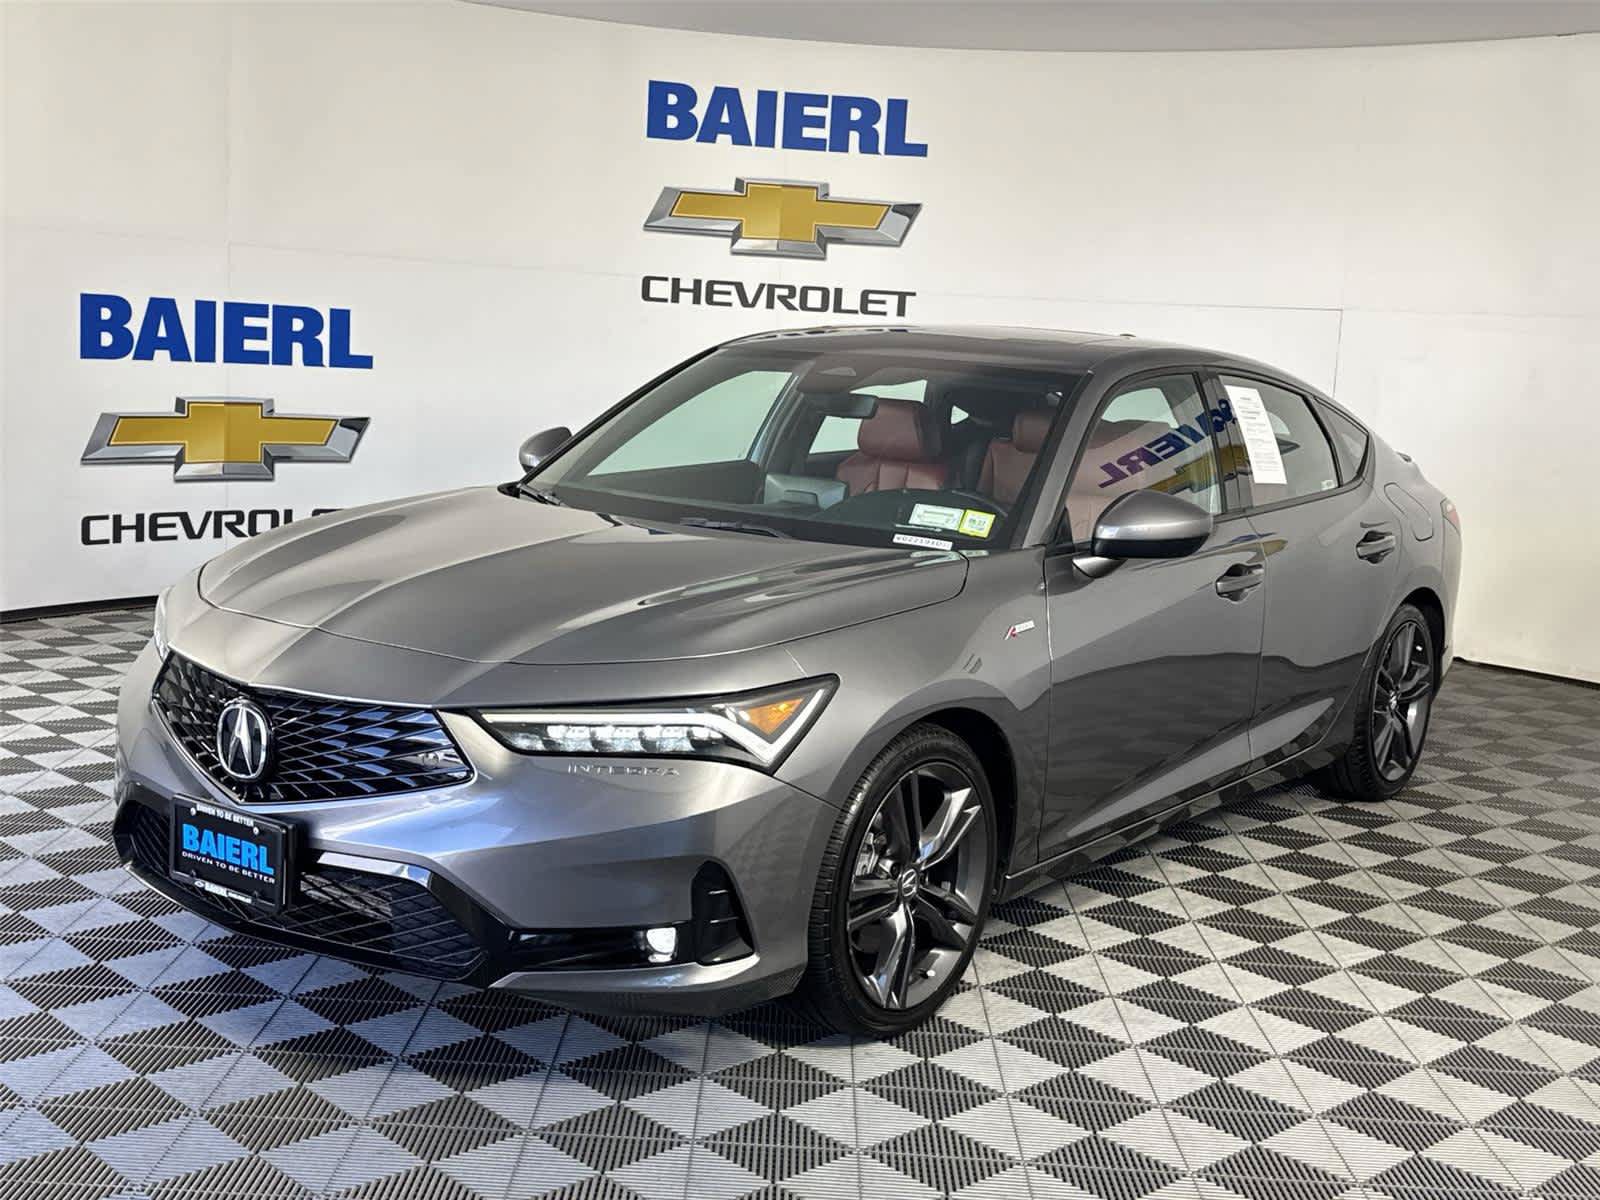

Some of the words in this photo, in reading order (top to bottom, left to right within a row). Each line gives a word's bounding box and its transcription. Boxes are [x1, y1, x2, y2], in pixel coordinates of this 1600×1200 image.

[647, 79, 929, 158] BAIERL
[641, 274, 917, 318] CHEVROLET
[79, 292, 374, 370] BAIERL
[80, 508, 343, 546] CHEVRO
[567, 763, 681, 777] INTEGRA
[181, 851, 214, 865] DRIVEN
[215, 861, 227, 870] TO
[228, 865, 240, 874] BE
[241, 868, 276, 884] BETTER
[182, 823, 275, 876] BAIERL
